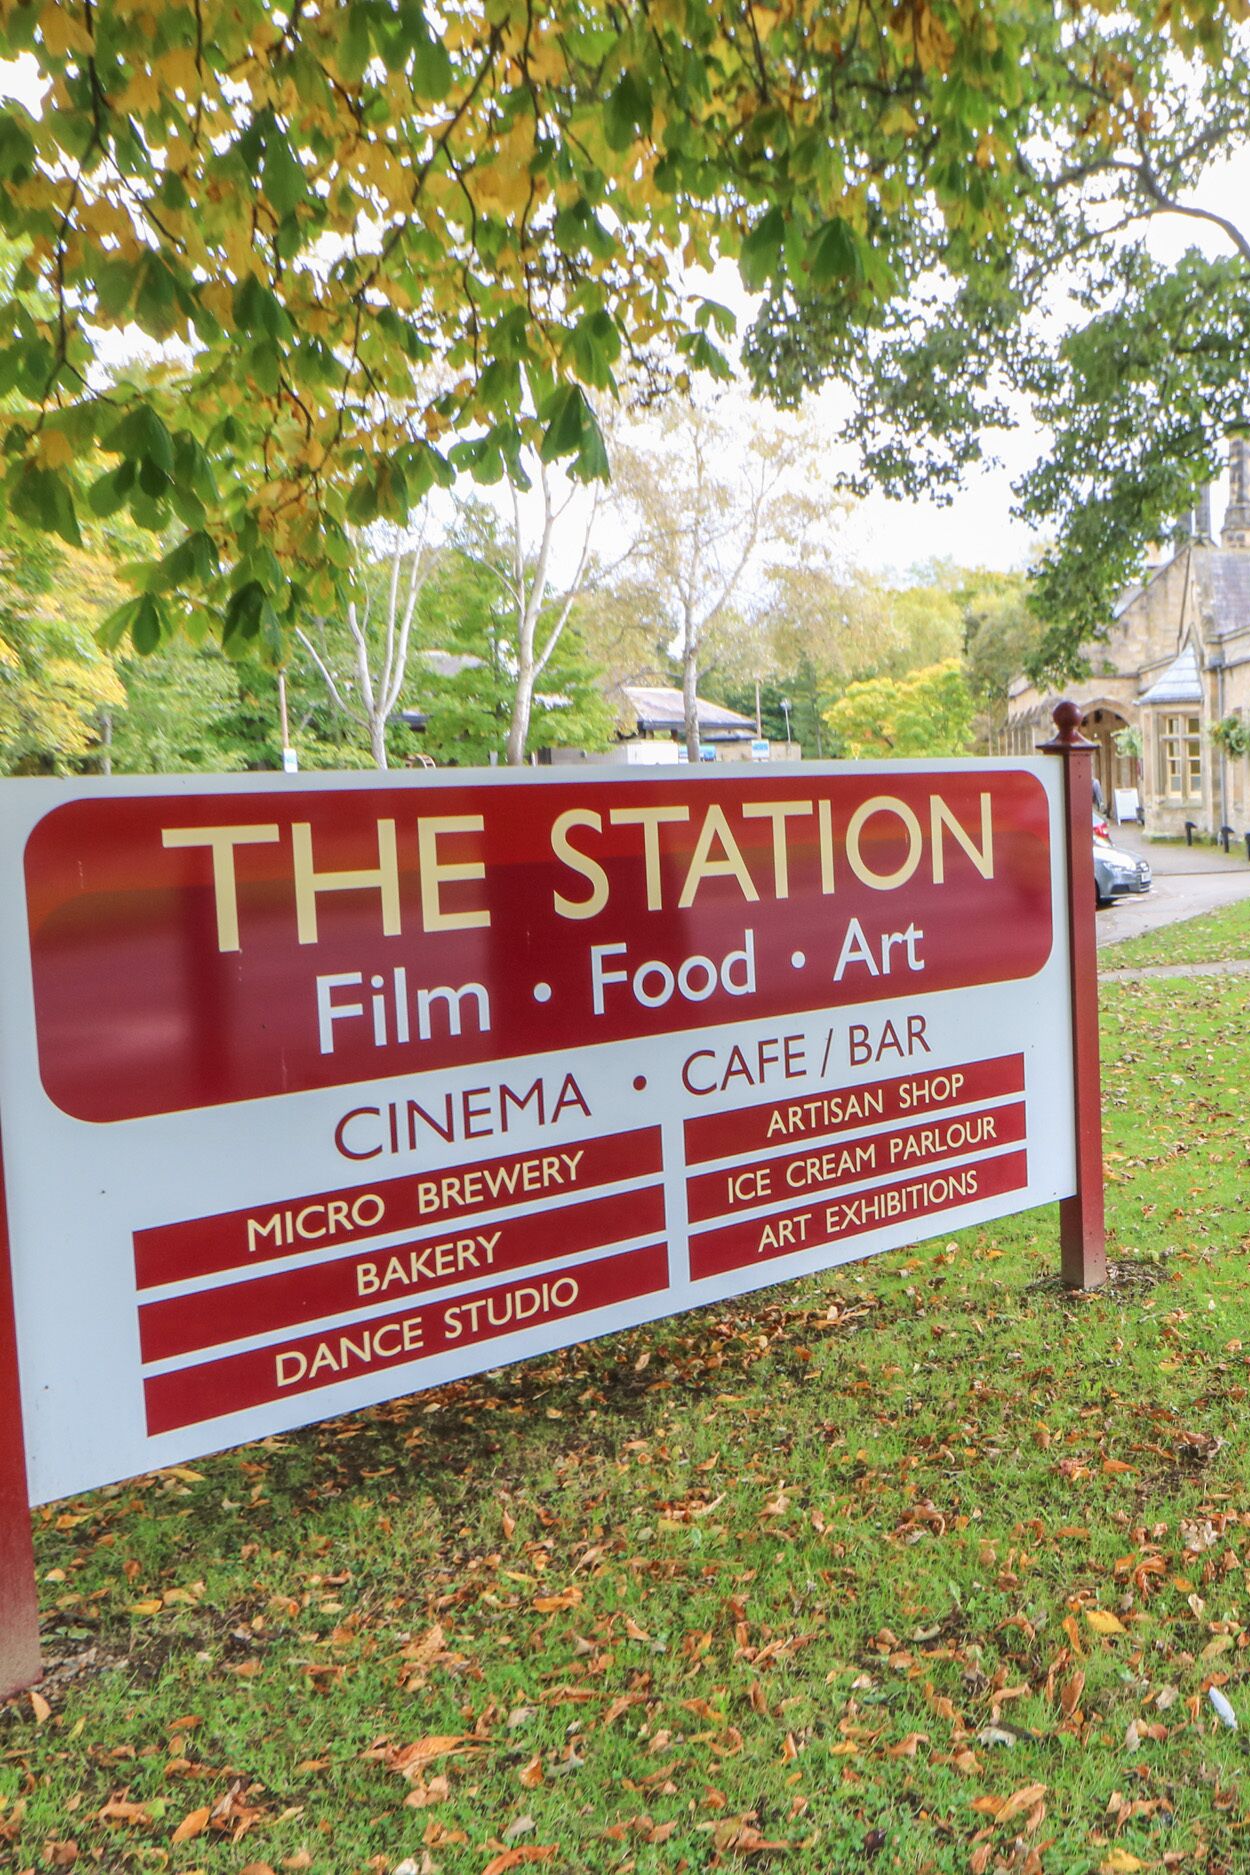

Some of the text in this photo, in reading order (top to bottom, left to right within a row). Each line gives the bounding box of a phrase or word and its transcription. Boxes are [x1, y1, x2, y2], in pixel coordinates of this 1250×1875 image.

[161, 792, 995, 953] THE STATION
[316, 917, 925, 1055] Film Food Art
[334, 1073, 592, 1162] CINEMA
[681, 1033, 807, 1096] CAFE
[848, 1014, 932, 1068] BAR
[766, 1073, 965, 1138] ARTISAN SHOP
[246, 1150, 585, 1253] MICRO BREWERY
[727, 1116, 998, 1204] ICE CREAM PARLOUR
[757, 1169, 979, 1253] ART EXHIBITIONS
[355, 1231, 503, 1297] BAKERY
[274, 1276, 580, 1388] DANCE STUDIO
